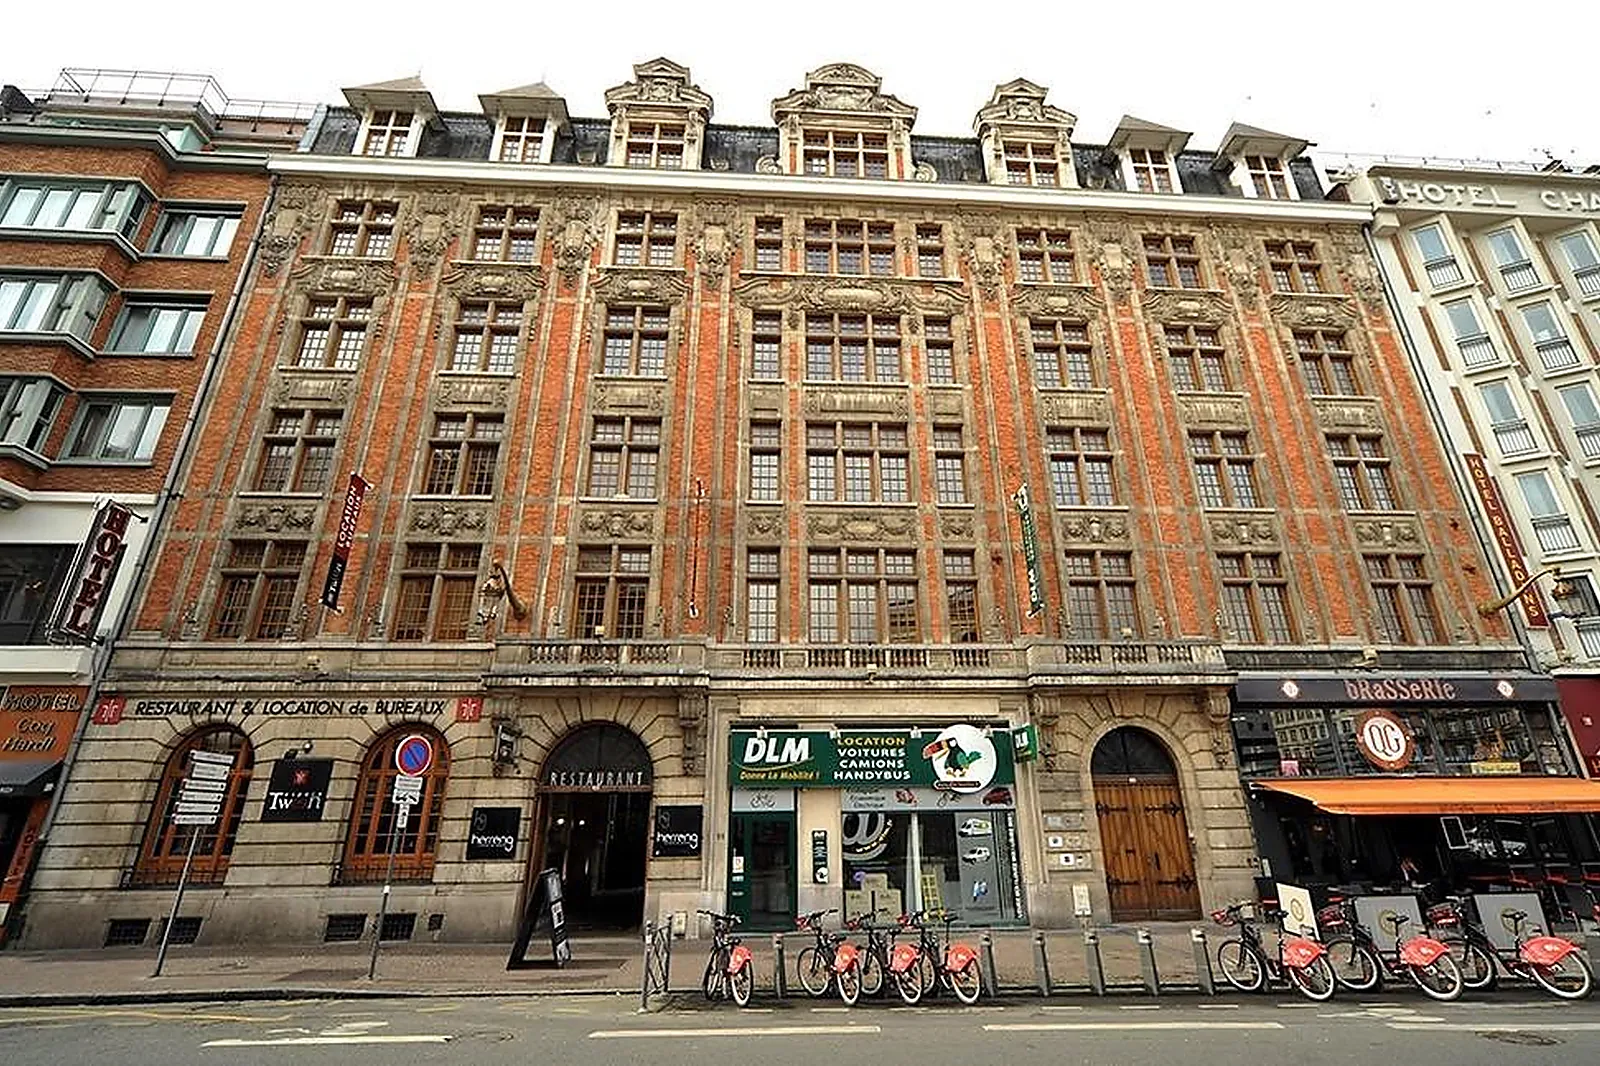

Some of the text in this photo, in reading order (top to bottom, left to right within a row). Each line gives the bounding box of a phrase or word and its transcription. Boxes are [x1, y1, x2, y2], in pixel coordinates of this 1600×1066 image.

[1398, 181, 1516, 208] HOTEL
[337, 485, 357, 548] LOCATION
[1469, 458, 1539, 617] HOTEL BALLADNS
[65, 505, 131, 634] HOTEL
[1, 692, 81, 712] HOTEL
[135, 700, 445, 716] RESTAURANT & LOCATION de BUREAUX
[744, 737, 809, 763] DLM
[1369, 724, 1401, 757] QG
[838, 748, 906, 757] VOITURES
[833, 771, 911, 780] HANDYBUS
[840, 760, 905, 769] CAMIONS
[550, 771, 643, 787] RESTAURANT
